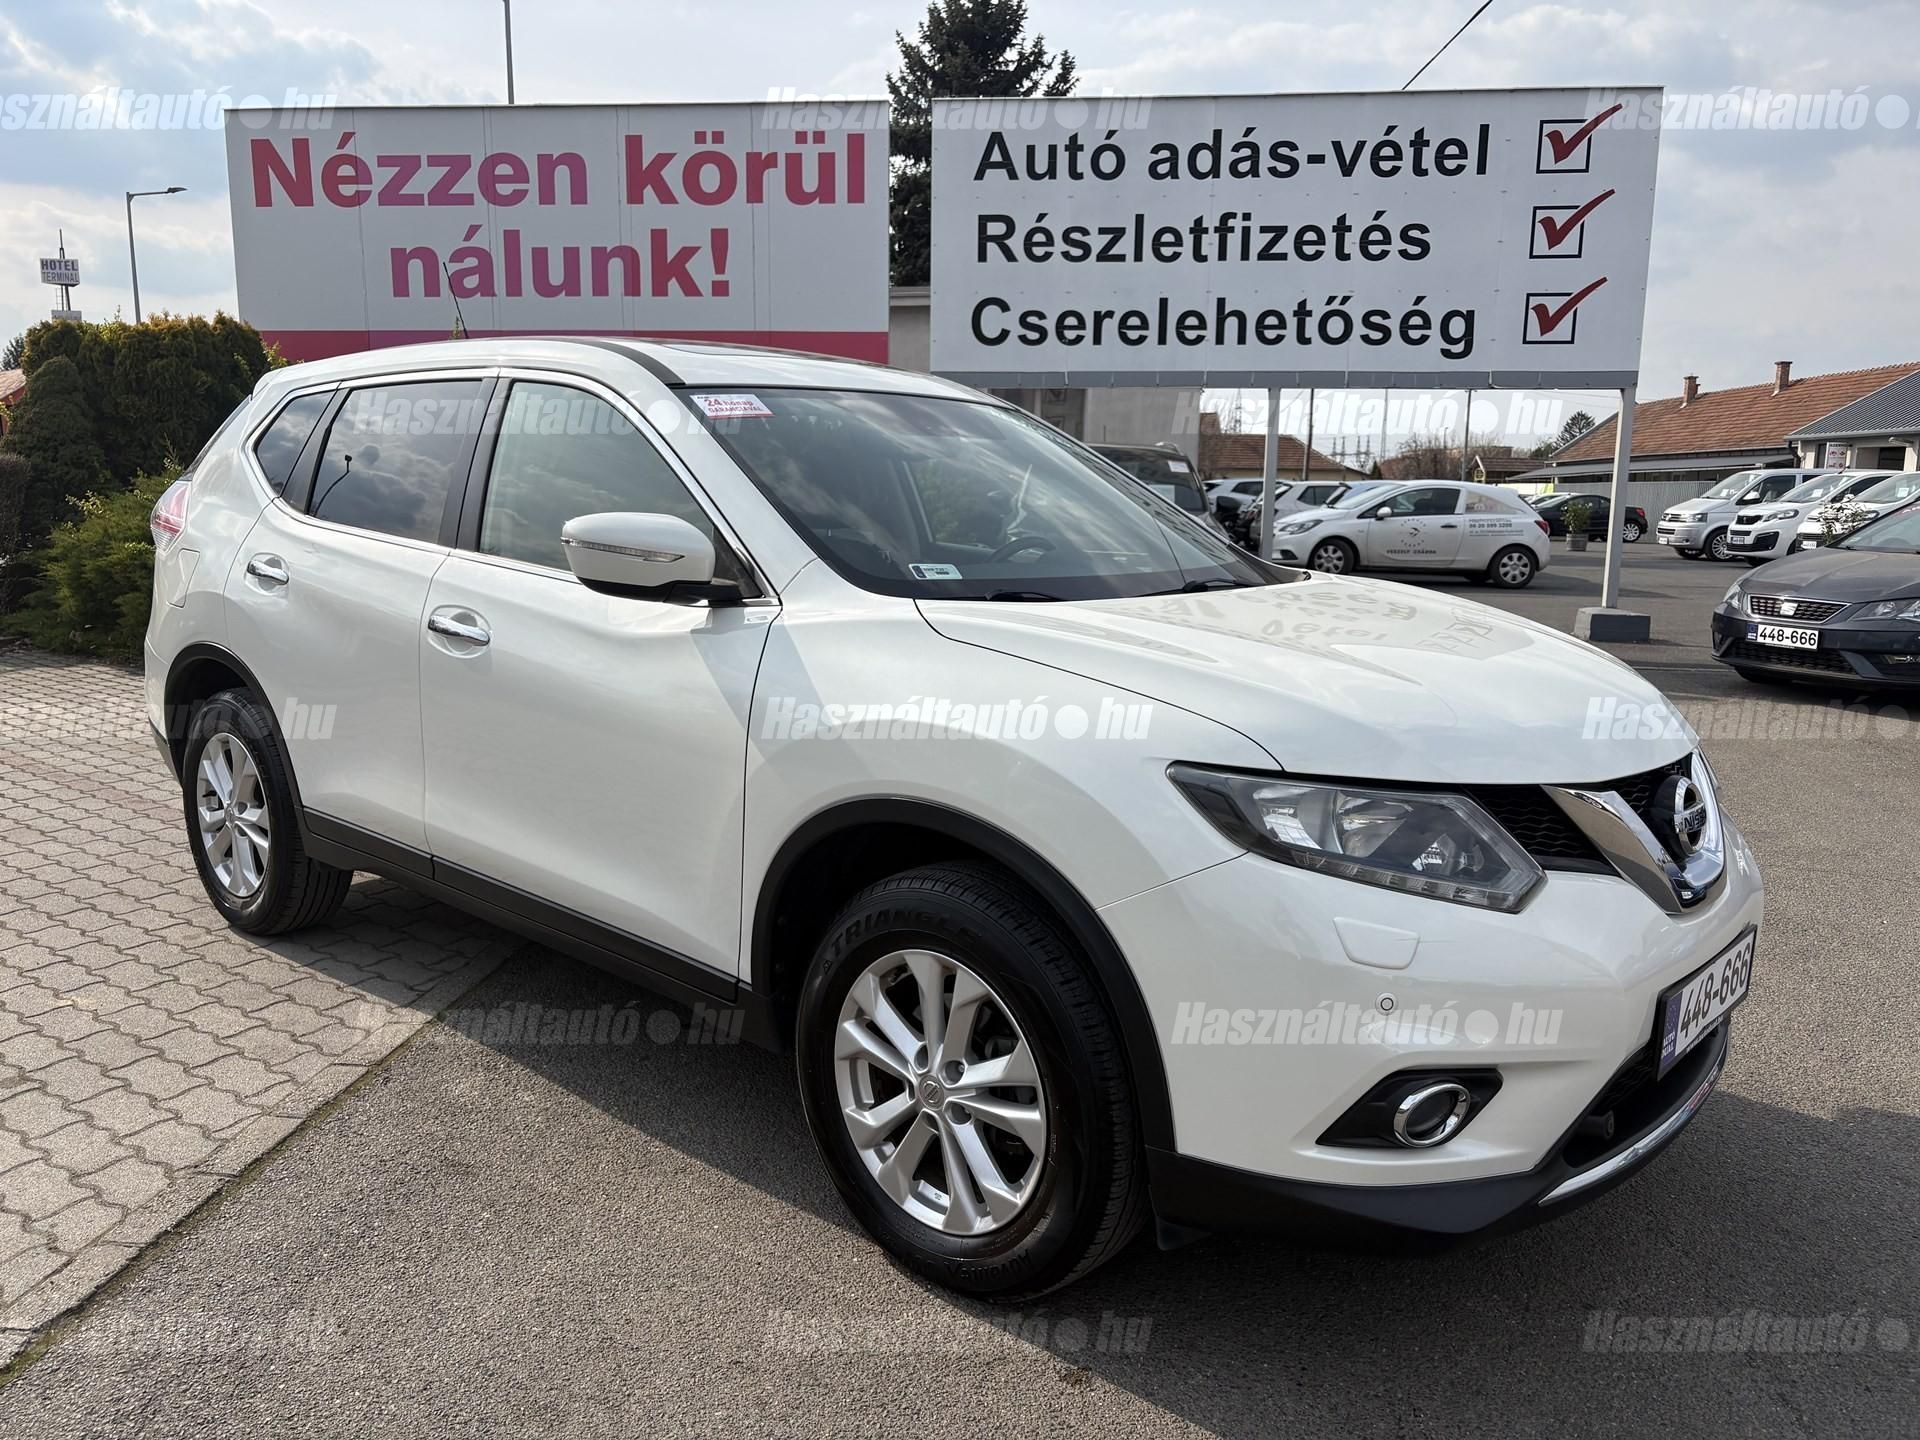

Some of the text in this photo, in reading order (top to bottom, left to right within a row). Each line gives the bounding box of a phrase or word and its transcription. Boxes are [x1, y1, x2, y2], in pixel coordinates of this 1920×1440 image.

[250, 131, 865, 208] Nézzen körül
[973, 124, 1490, 181] Autó adás-vétel
[41, 260, 79, 271] HOTEL
[390, 224, 729, 298] nálunk!
[977, 210, 1431, 264] Részletfizetés
[42, 271, 80, 282] TERMINAL
[971, 296, 1476, 360] Cserelehetőség
[1759, 627, 1817, 647] 448-666
[1680, 942, 1751, 1039] 448-666
